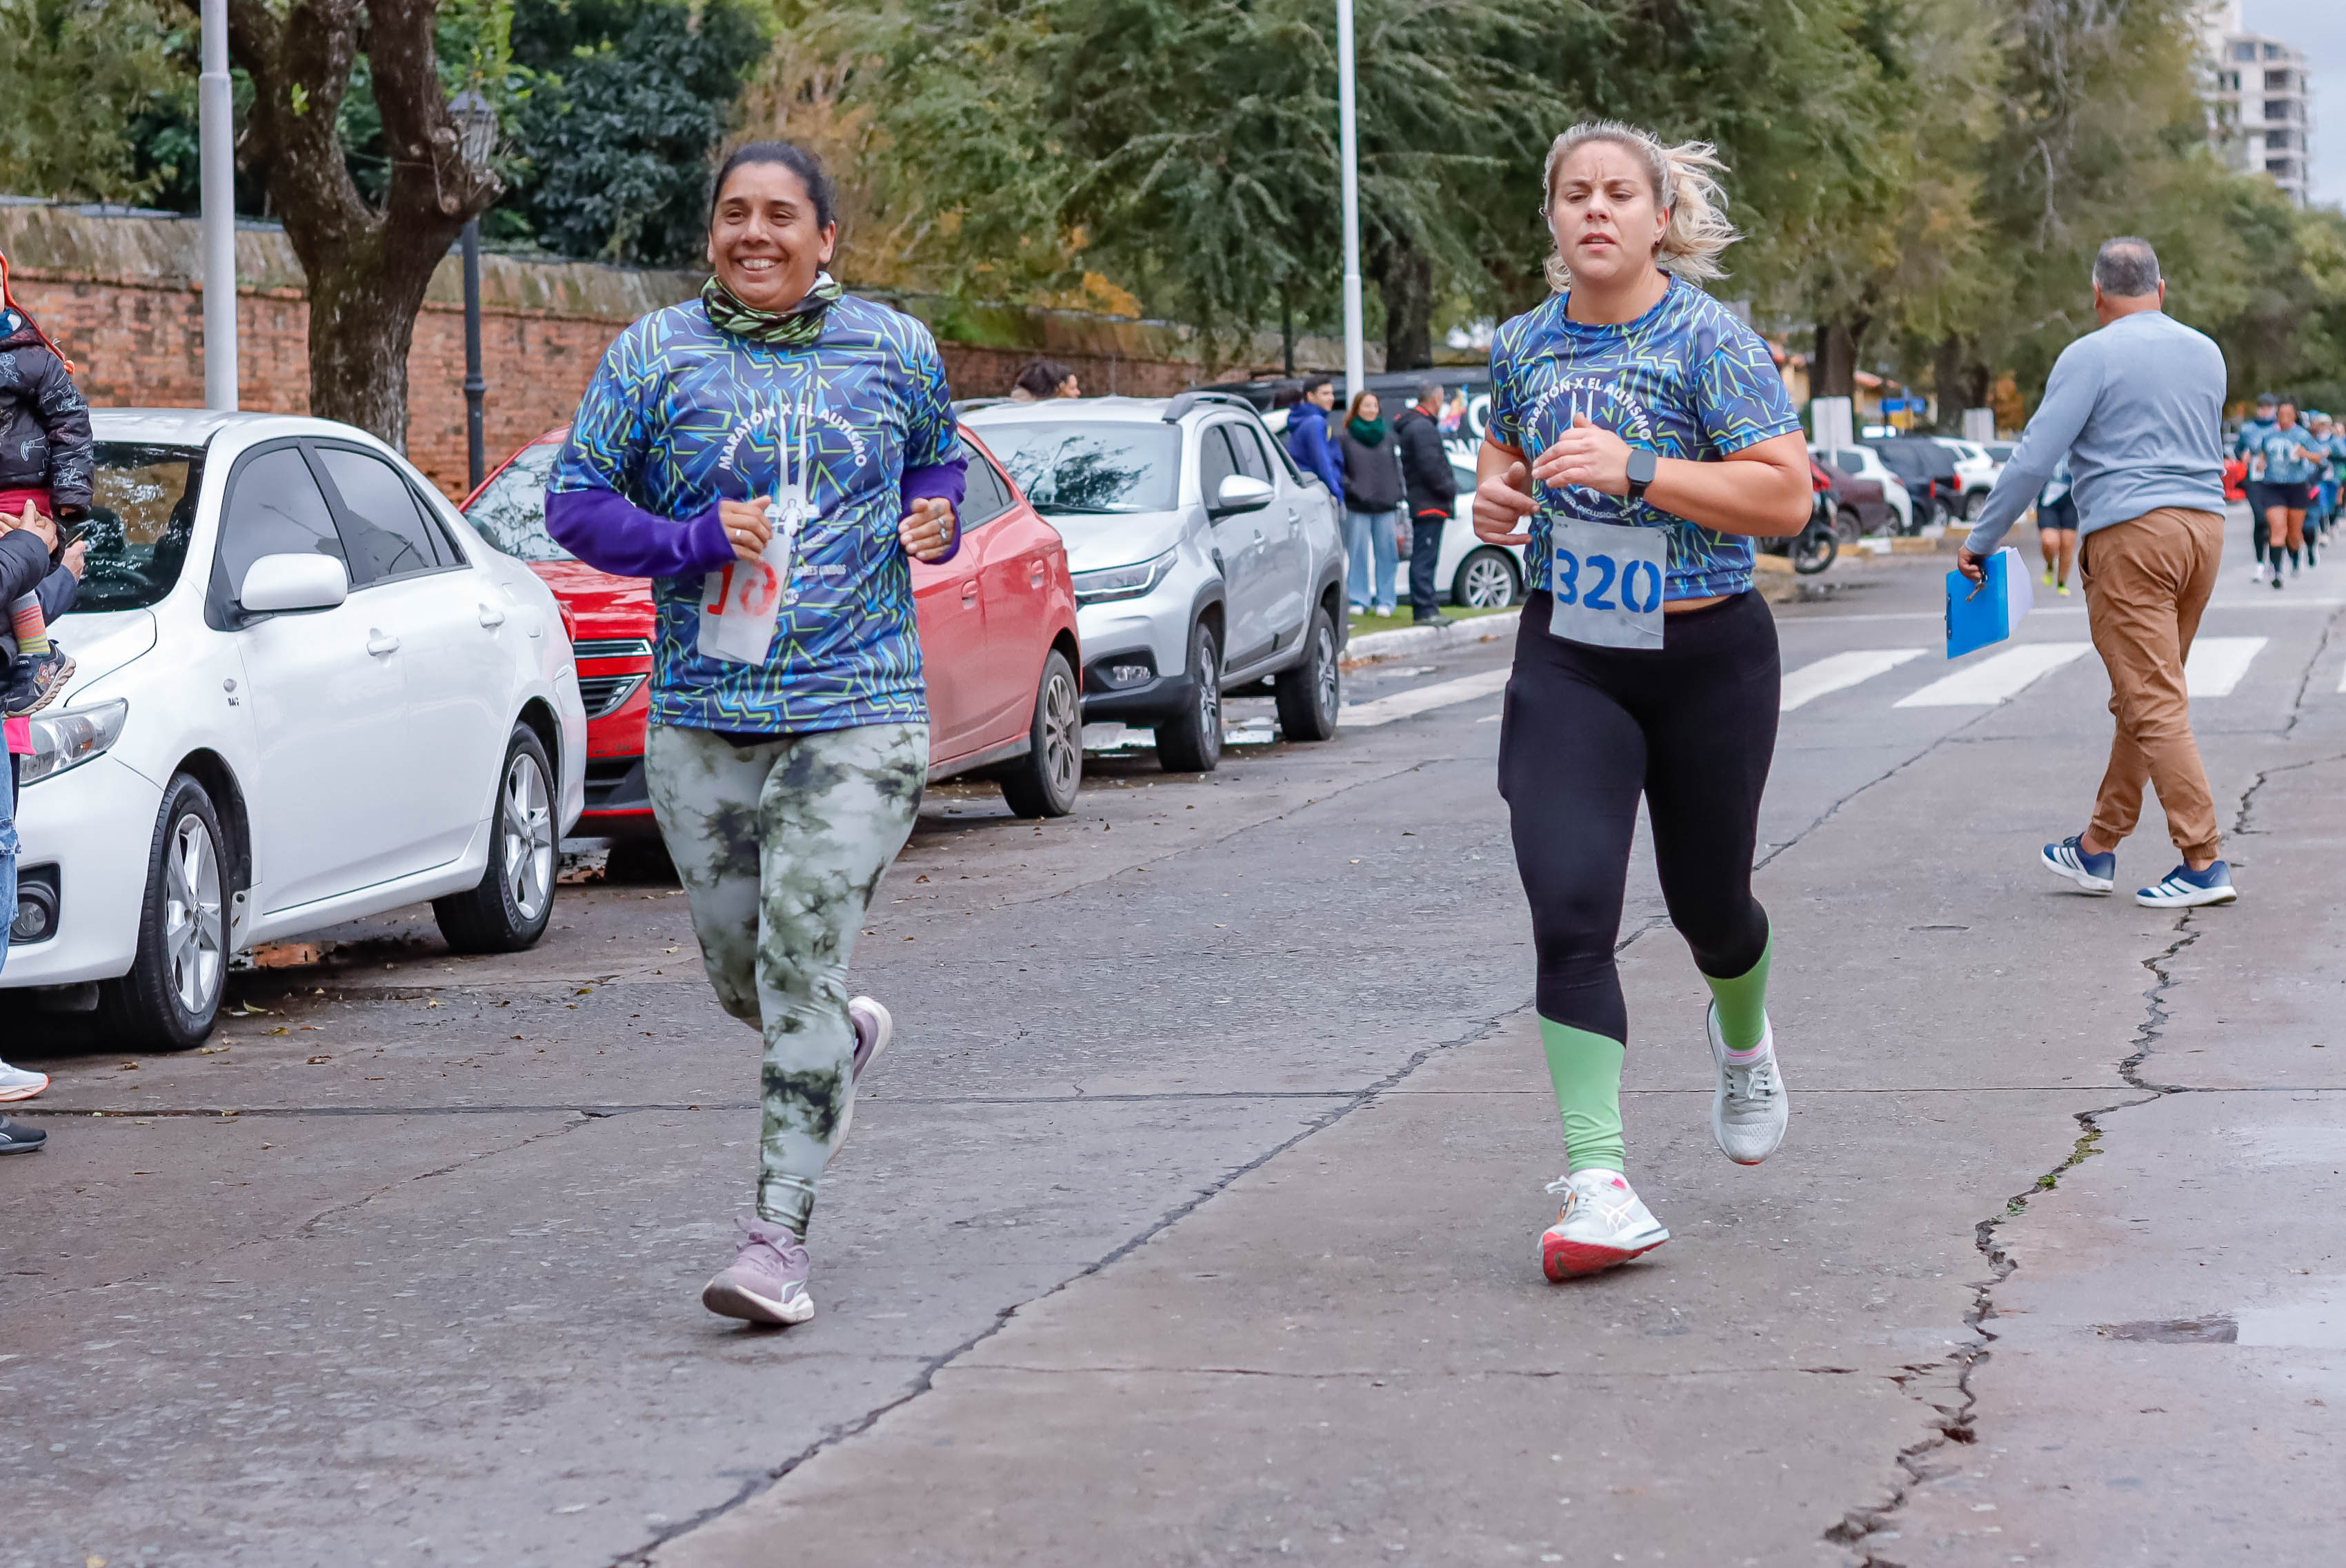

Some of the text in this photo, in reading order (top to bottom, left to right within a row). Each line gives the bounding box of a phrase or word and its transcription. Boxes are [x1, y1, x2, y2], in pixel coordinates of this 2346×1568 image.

[719, 403, 867, 470] MARATON X EL AUTISMO
[1573, 377, 1584, 389] X
[1587, 377, 1602, 391] EL
[1603, 384, 1652, 441] AUTISMO
[1557, 548, 1661, 614] 320
